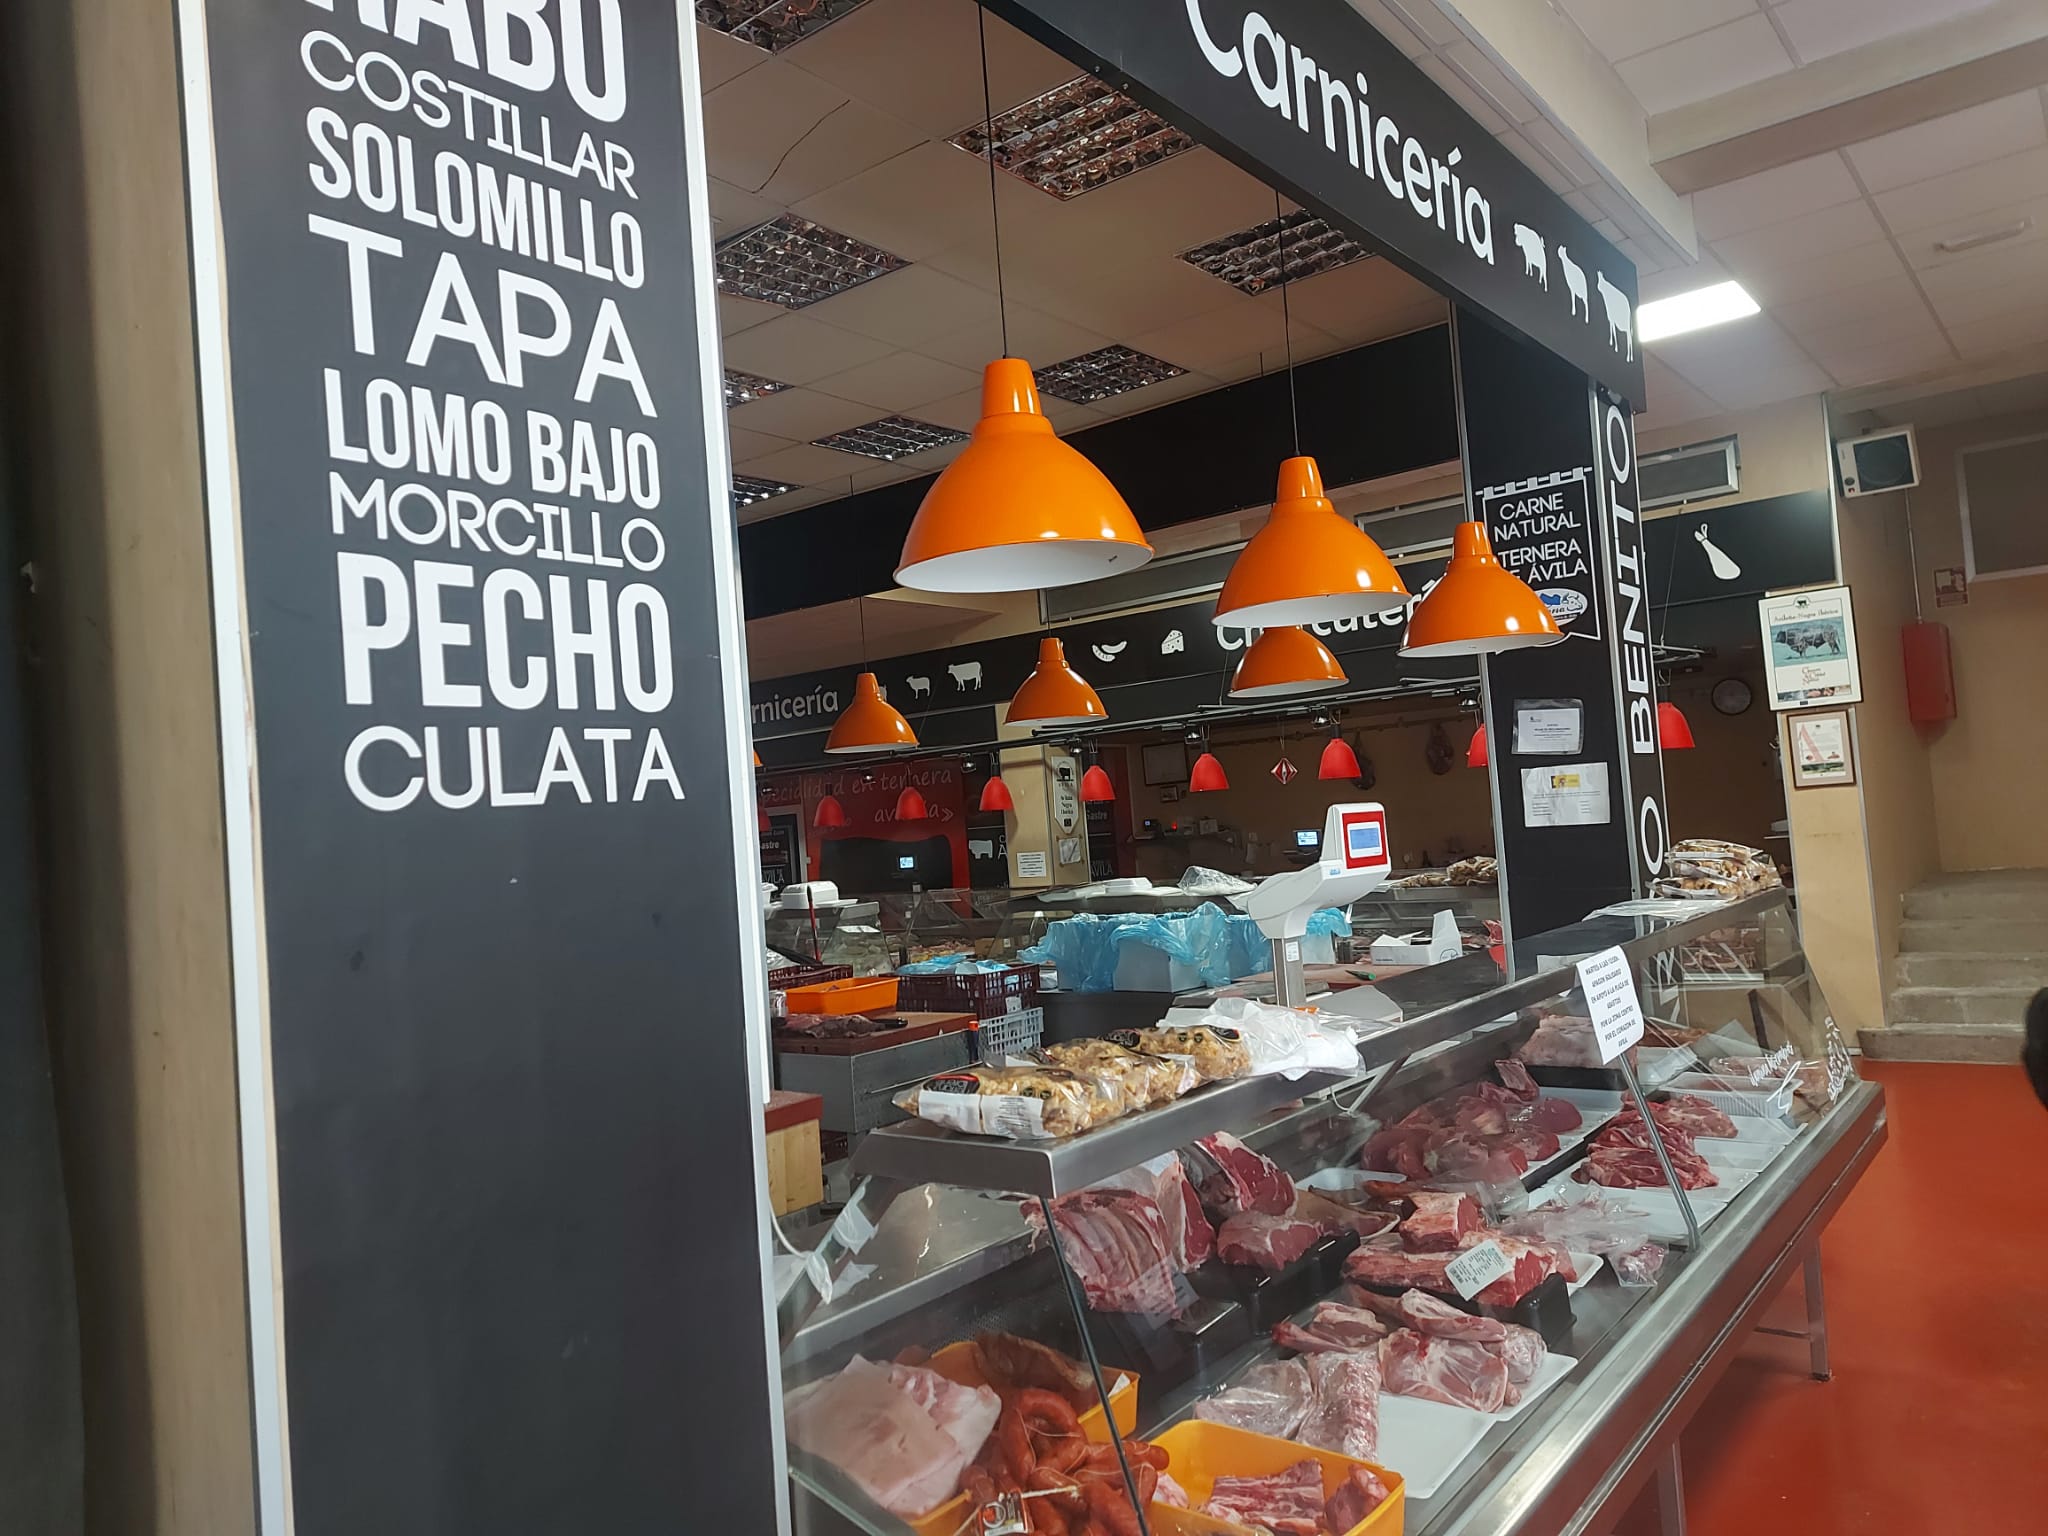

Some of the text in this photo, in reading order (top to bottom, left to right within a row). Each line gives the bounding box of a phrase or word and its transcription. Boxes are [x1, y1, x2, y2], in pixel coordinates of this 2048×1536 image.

[300, 30, 639, 199] COSTILLAR
[1184, 0, 1495, 265] Carnicería
[306, 106, 646, 289] SOLOMILLO
[308, 213, 658, 418] TAPA
[324, 367, 661, 510] LOMO BAJO
[329, 471, 665, 572] MORCILLO
[1494, 511, 1581, 542] NATURAL
[1498, 538, 1581, 568] TERNERA
[1500, 492, 1564, 521] CARNE
[336, 551, 674, 713] PECHO
[1527, 560, 1588, 584] ÁVILA
[1606, 404, 1655, 754] BENITO
[752, 684, 838, 724] rnicería
[344, 725, 685, 812] CULATA
